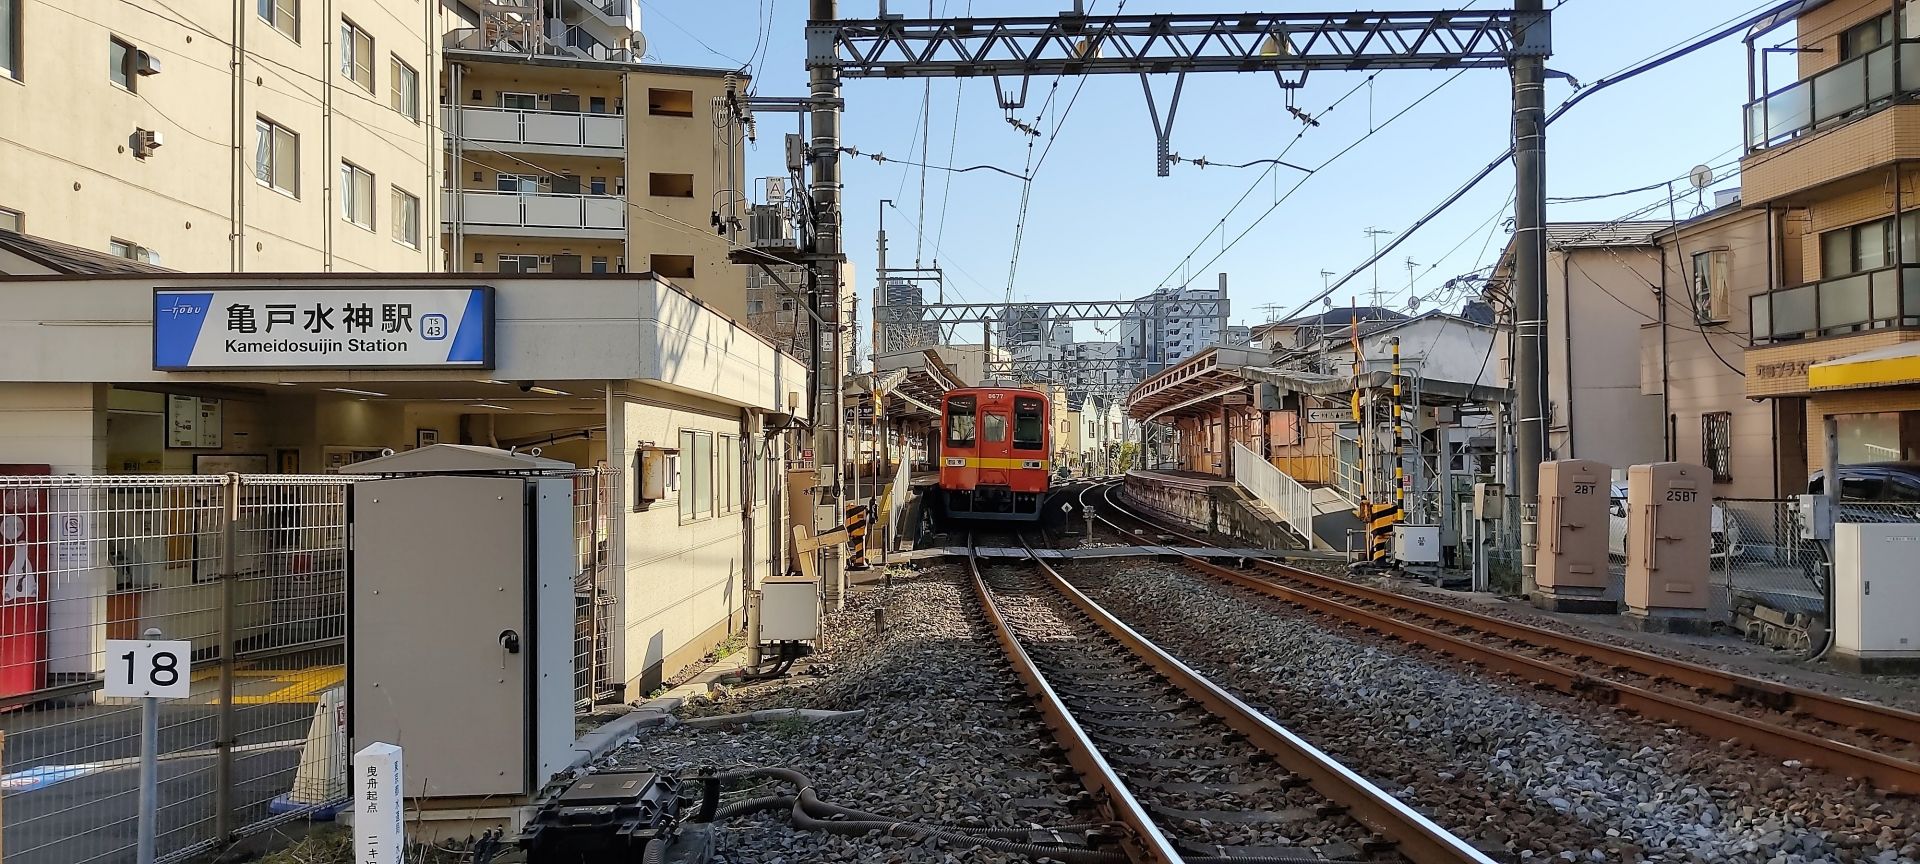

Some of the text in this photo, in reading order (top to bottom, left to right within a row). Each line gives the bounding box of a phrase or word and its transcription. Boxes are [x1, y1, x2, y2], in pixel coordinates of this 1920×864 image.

[226, 303, 413, 334] 亀戸水神駅
[427, 326, 441, 336] 43
[225, 339, 407, 355] Kameidosuijin Station
[1574, 485, 1596, 495] 2BT
[1666, 490, 1697, 502] 25BT
[122, 651, 179, 687] 18
[366, 766, 379, 814] 曳舟起点
